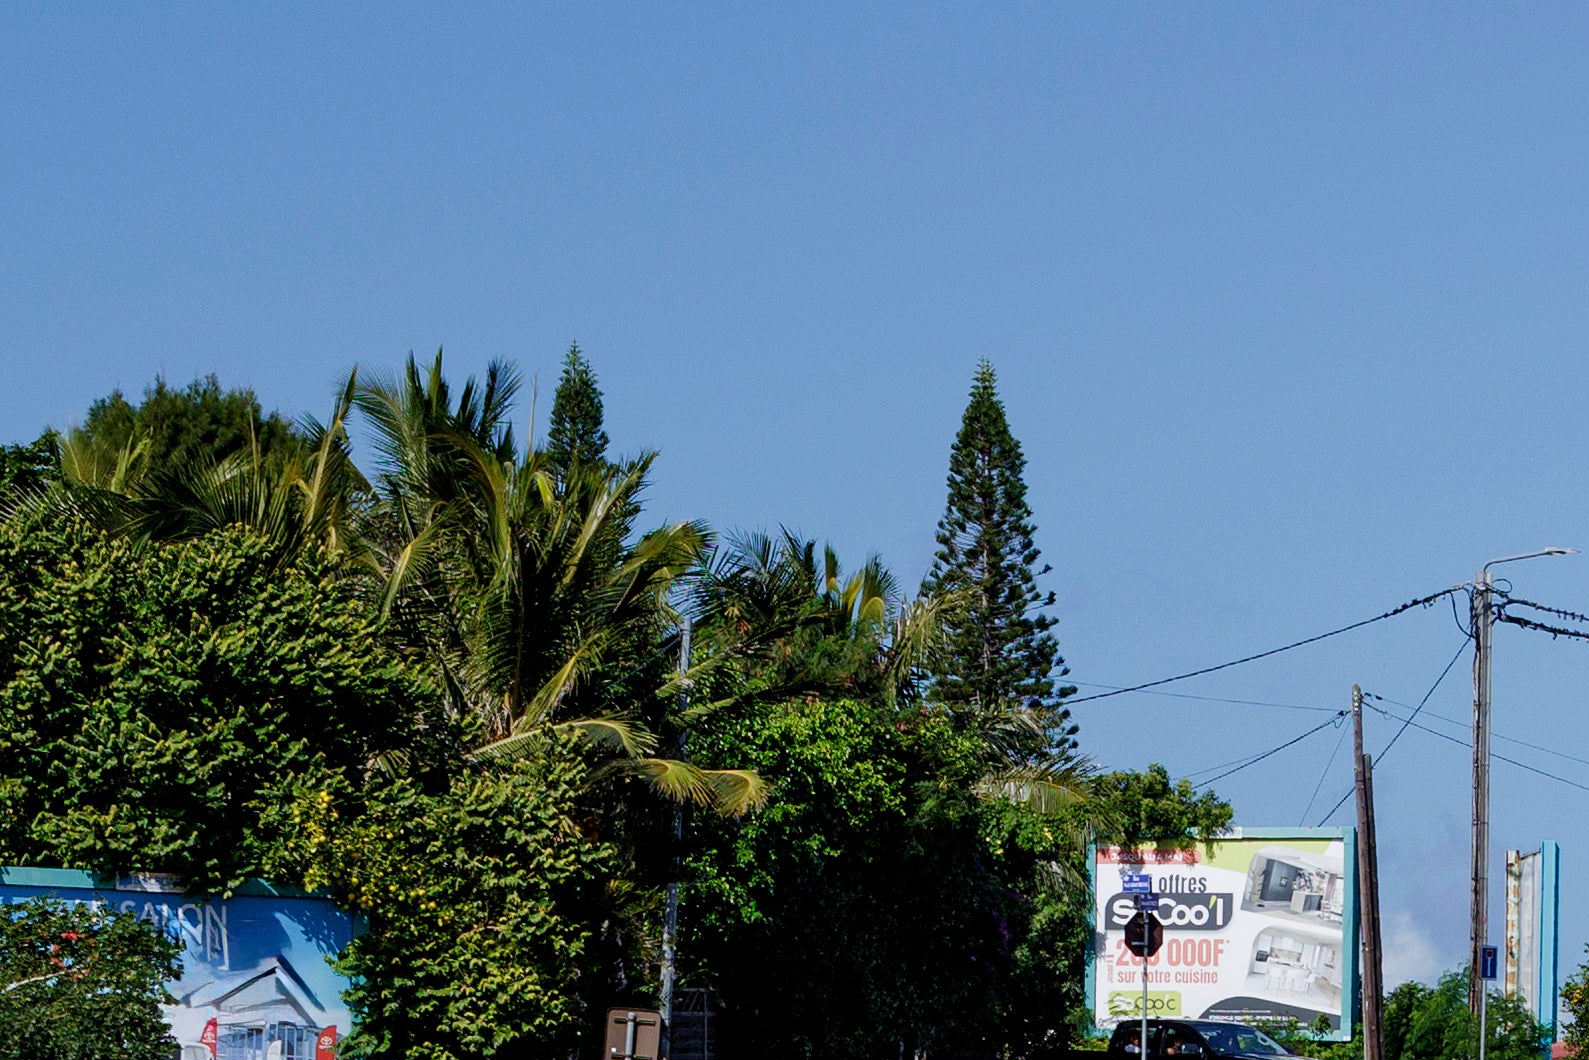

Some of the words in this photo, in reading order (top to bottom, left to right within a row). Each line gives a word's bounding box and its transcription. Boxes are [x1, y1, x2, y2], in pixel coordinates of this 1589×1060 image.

[1159, 875, 1208, 893] offres
[1112, 895, 1224, 926] SCoo'l
[1117, 970, 1137, 983] sur
[1174, 968, 1218, 984] cuisine
